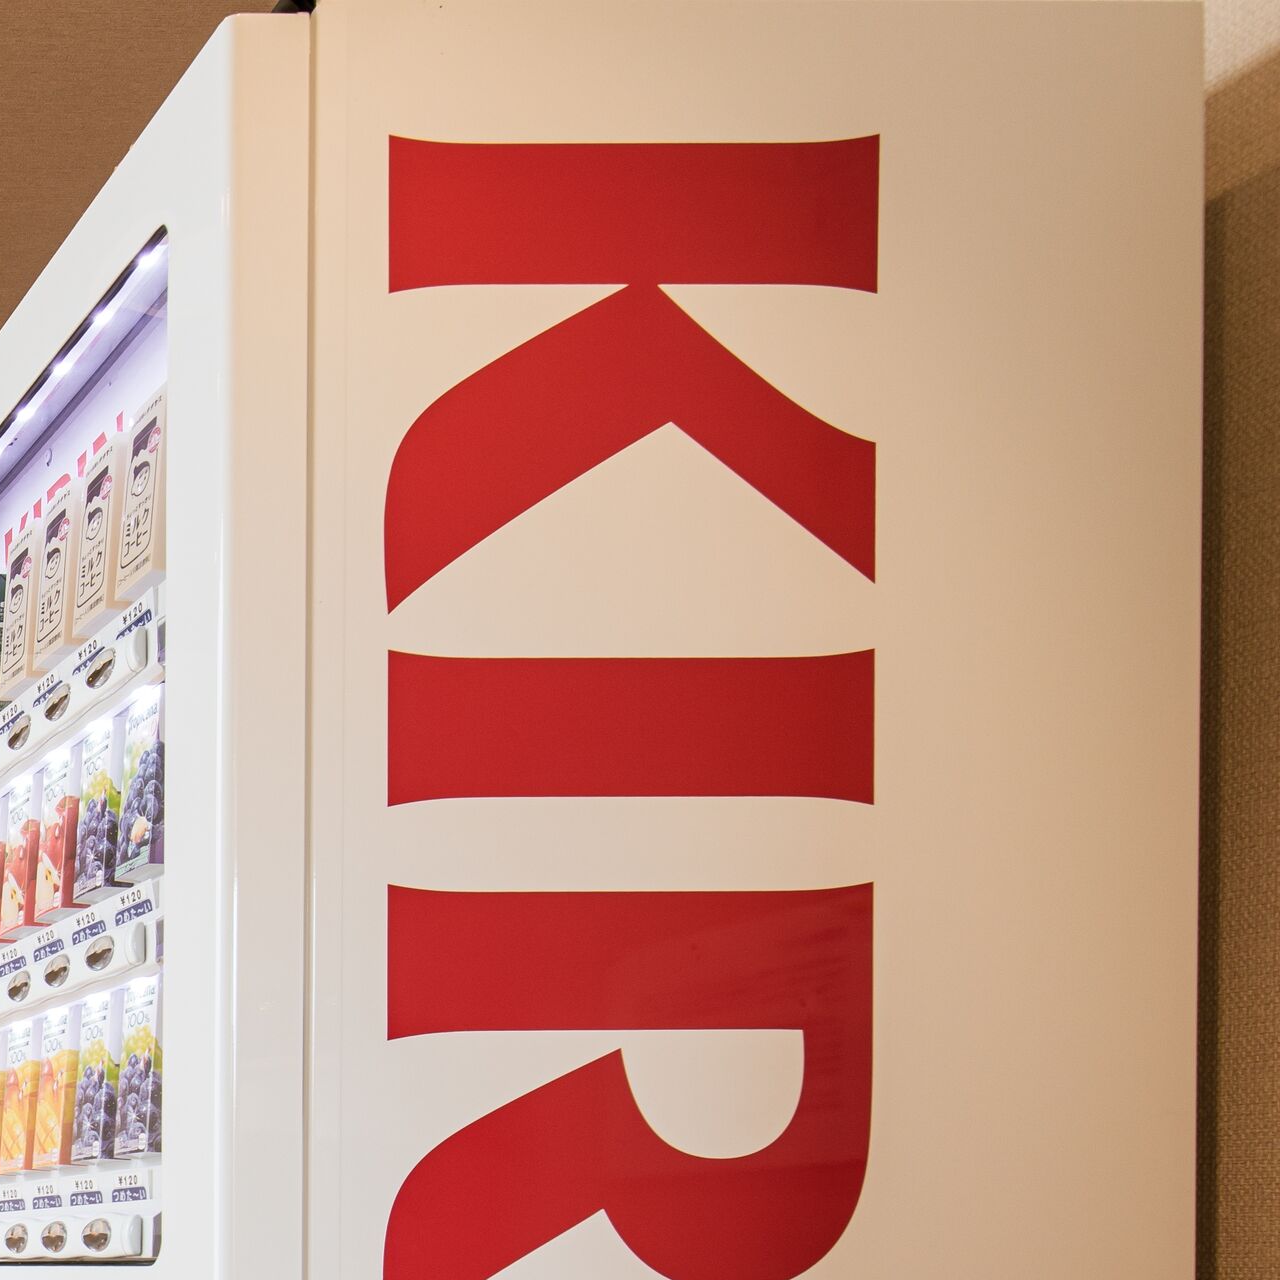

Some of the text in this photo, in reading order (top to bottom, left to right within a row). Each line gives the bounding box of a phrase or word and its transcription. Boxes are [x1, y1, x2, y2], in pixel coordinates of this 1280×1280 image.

[125, 507, 151, 538] ミルク
[123, 530, 149, 557] コーヒー
[81, 551, 103, 579] ミルク
[79, 571, 102, 598] コーヒー
[41, 590, 61, 615] ミルク
[39, 609, 61, 633] コーヒー
[120, 890, 142, 906] ¥120
[76, 912, 96, 927] ¥120
[37, 930, 55, 944] ¥120
[2, 949, 18, 962] ¥120
[75, 1180, 94, 1190] ¥120
[118, 1175, 138, 1186] ¥120
[2, 1190, 18, 1199] ¥120
[37, 1185, 54, 1195] ¥120
